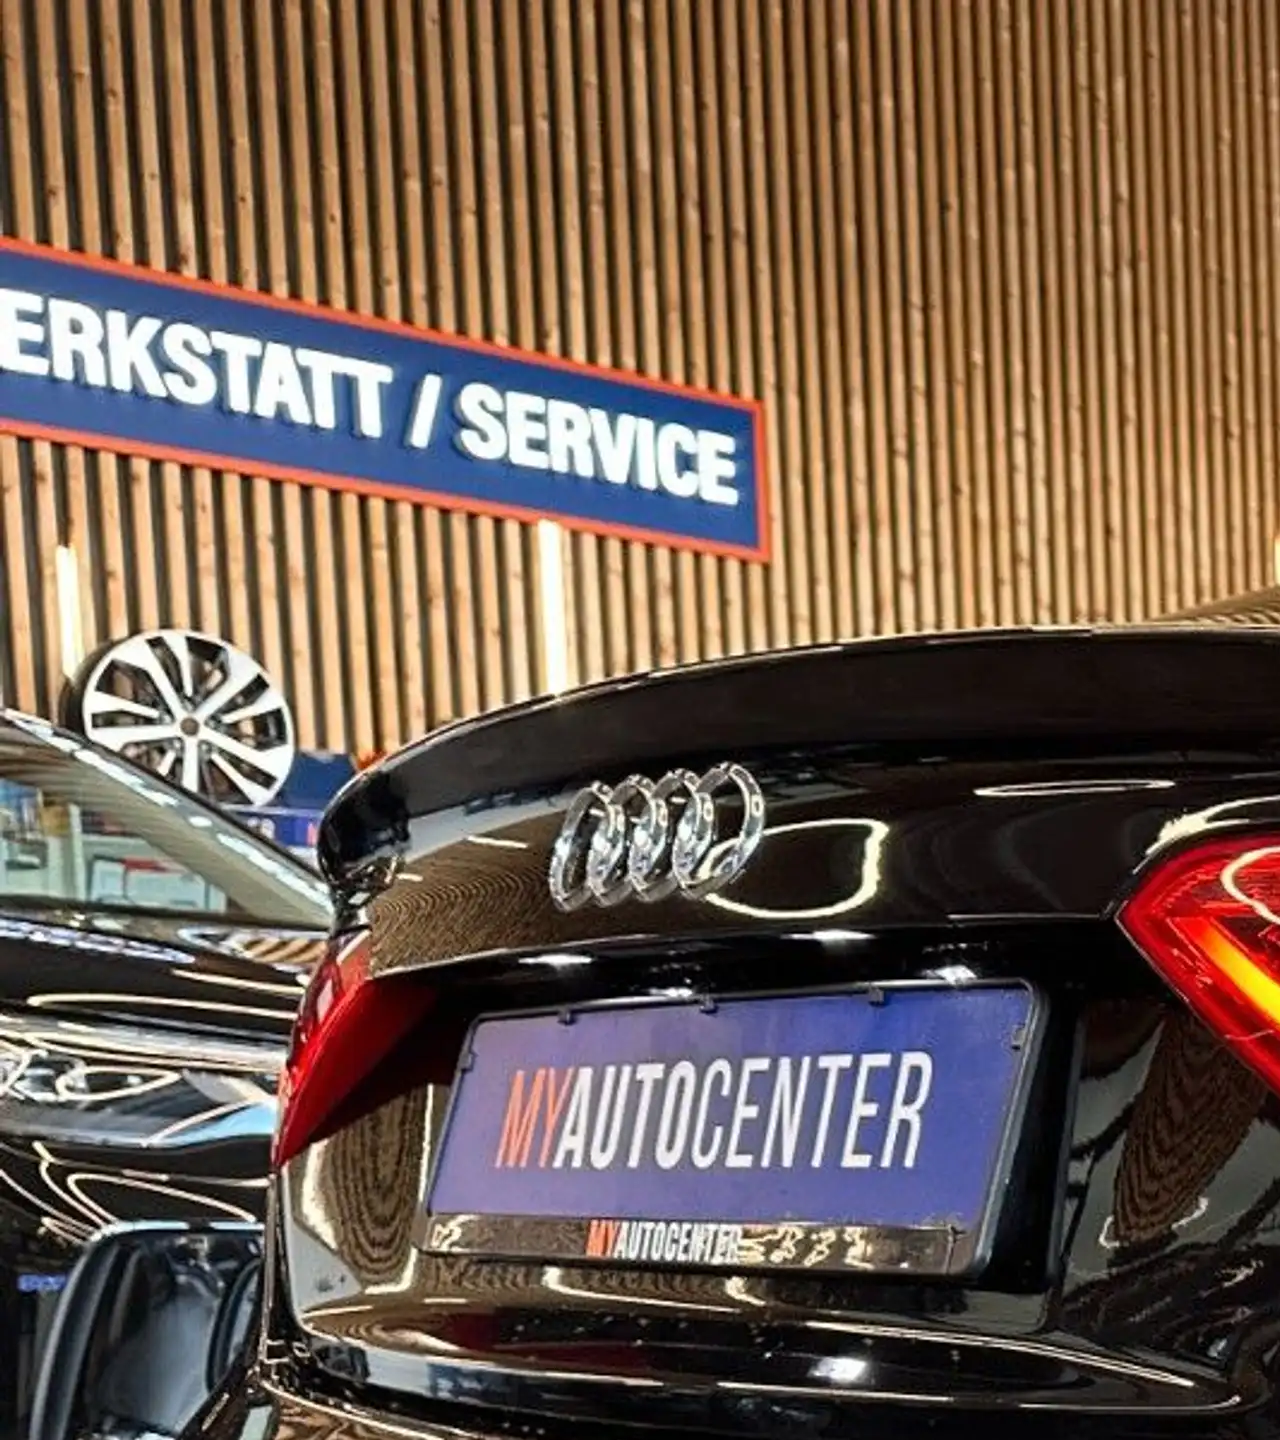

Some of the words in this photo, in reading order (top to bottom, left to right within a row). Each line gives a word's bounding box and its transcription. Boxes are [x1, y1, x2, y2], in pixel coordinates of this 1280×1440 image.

[0, 288, 393, 439] ERKSTATT
[410, 374, 442, 449] /
[459, 382, 739, 505] SERVICE
[494, 1050, 933, 1169] MYAUTOCENTER
